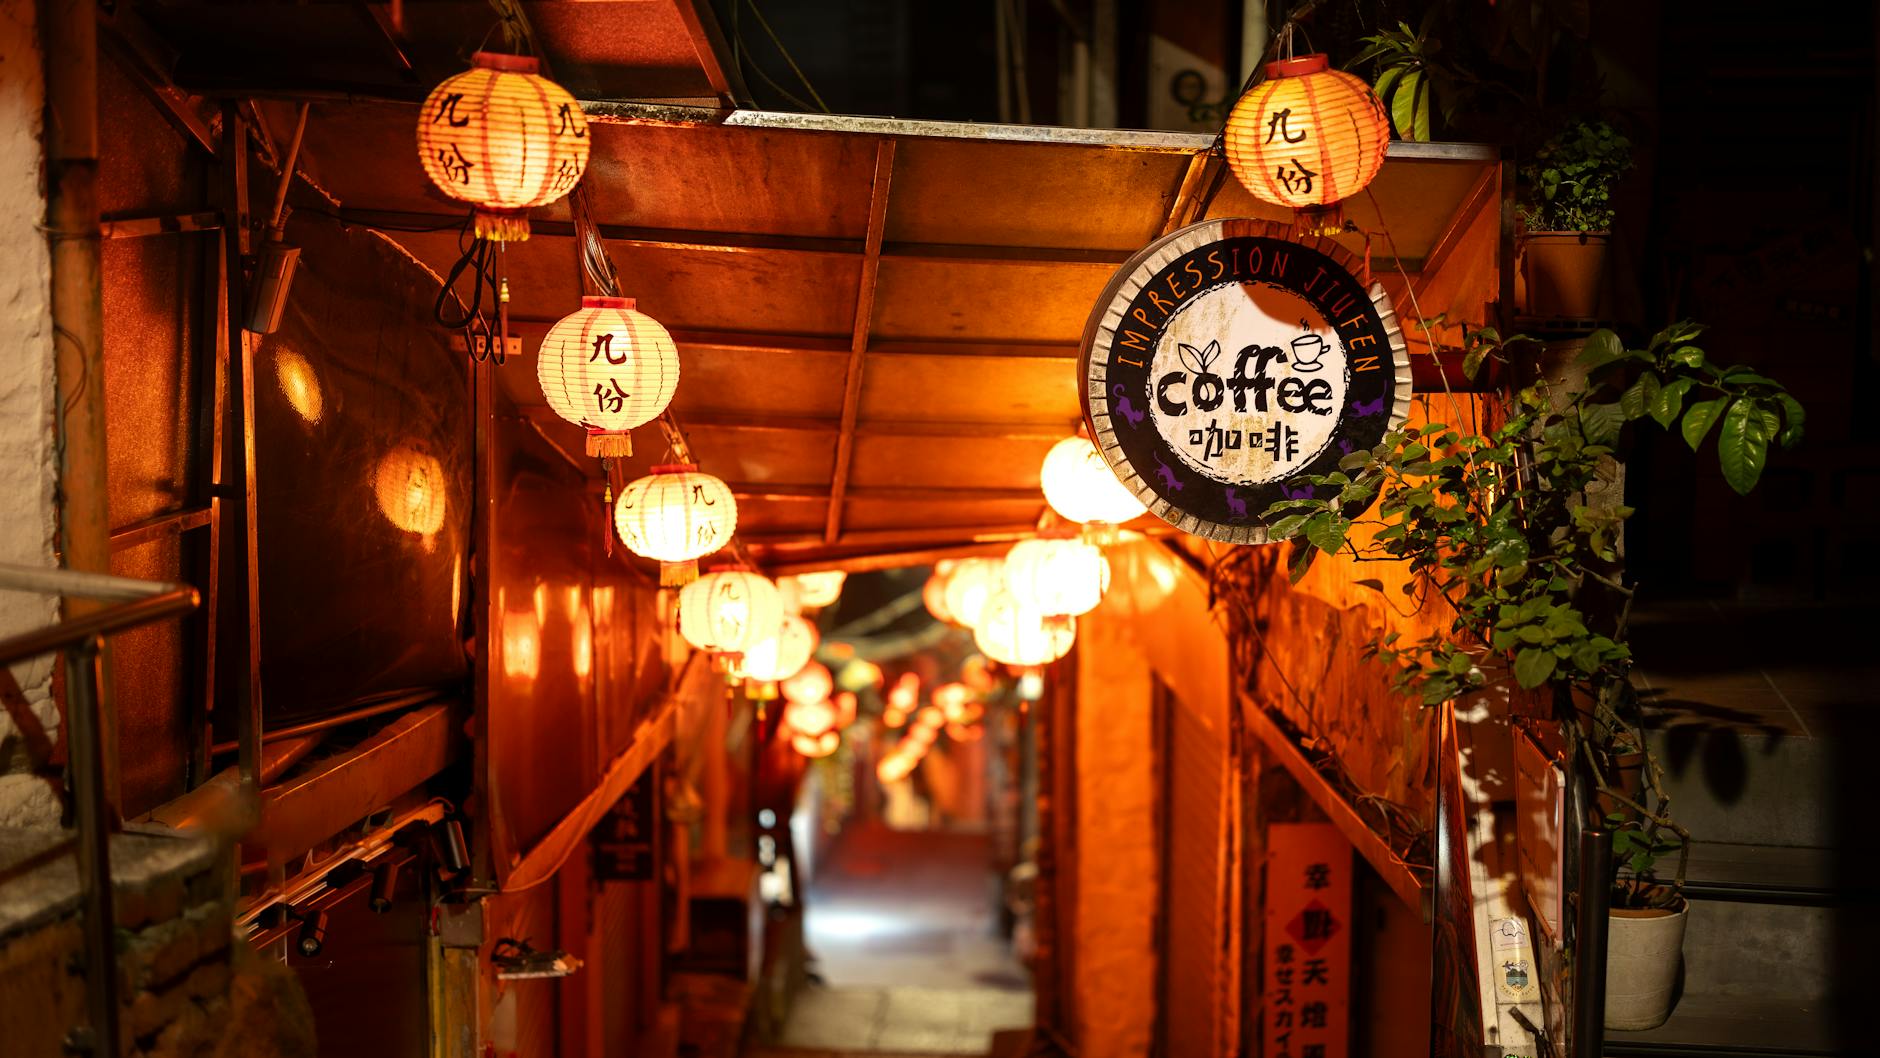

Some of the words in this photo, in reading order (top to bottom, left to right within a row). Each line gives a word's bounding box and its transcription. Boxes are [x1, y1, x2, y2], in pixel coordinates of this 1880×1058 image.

[432, 92, 474, 186] 九份
[1265, 107, 1319, 195] 九份
[1117, 246, 1289, 369] IMPRESSION
[1303, 266, 1381, 373] JIUFEN
[589, 333, 630, 414] 九份
[1156, 343, 1333, 417] coffee
[1188, 418, 1300, 462] 咖啡
[1274, 944, 1295, 1058] 幸せスカイ
